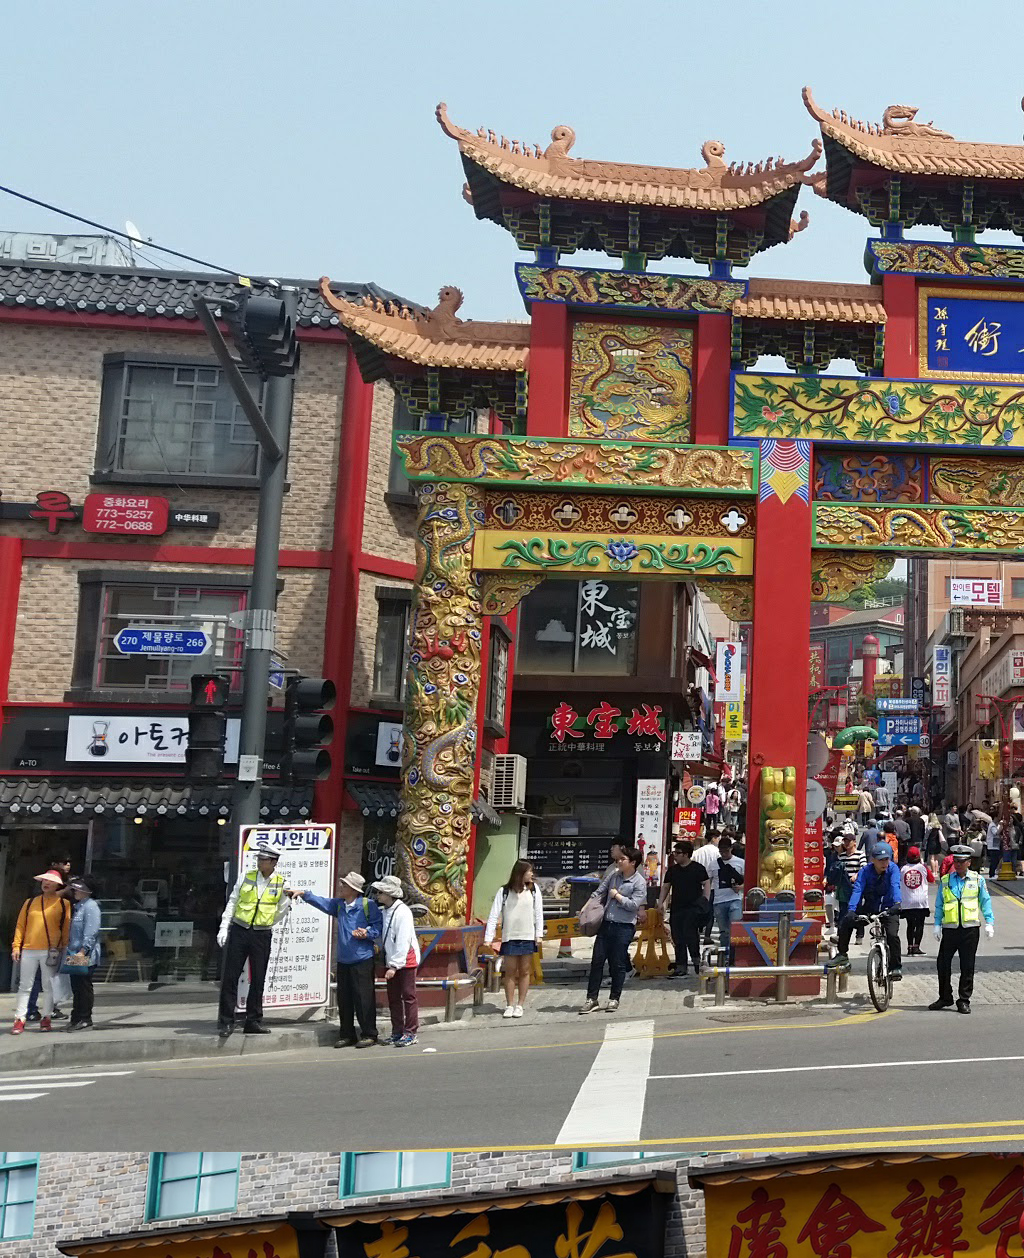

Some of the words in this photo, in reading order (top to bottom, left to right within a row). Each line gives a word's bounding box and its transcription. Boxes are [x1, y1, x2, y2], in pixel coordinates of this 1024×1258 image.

[104, 498, 148, 508] 중화요리
[97, 509, 153, 519] 773-5257
[175, 514, 208, 523] 中华料理
[96, 520, 152, 530] 772-0688
[952, 583, 971, 591] 화이트
[972, 582, 1000, 604] 모텔
[122, 637, 137, 645] 270
[142, 632, 183, 643] 제물량로
[187, 638, 203, 647] 266
[887, 720, 894, 732] P
[634, 742, 660, 752] 동보성
[352, 766, 363, 774] Take
[255, 832, 320, 847] 공사안내
